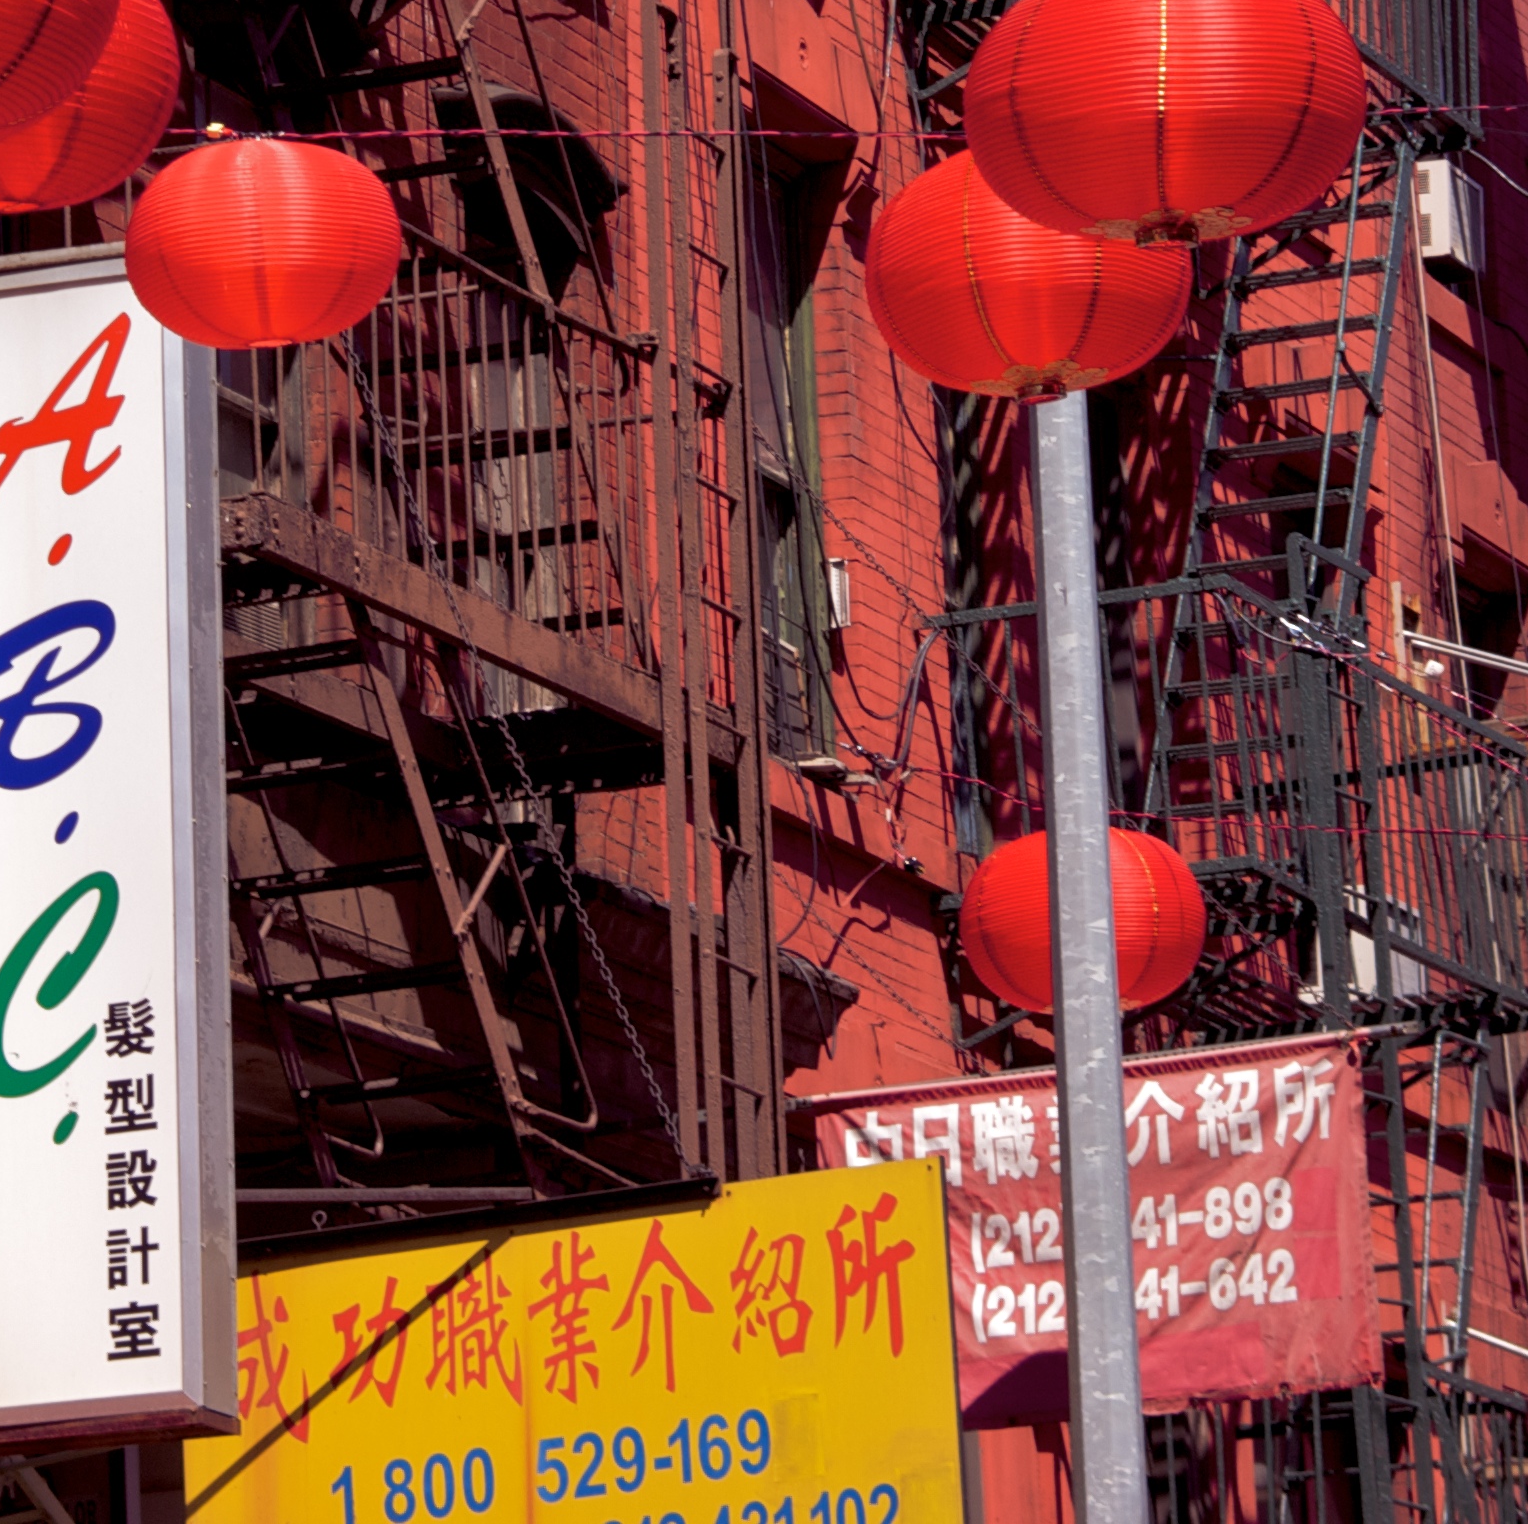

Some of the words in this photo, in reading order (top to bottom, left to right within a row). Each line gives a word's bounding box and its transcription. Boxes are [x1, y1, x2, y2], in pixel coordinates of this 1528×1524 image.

[103, 998, 162, 1362] 髮型設計室
[383, 1446, 497, 1524] 800
[535, 1408, 773, 1504] 529-169
